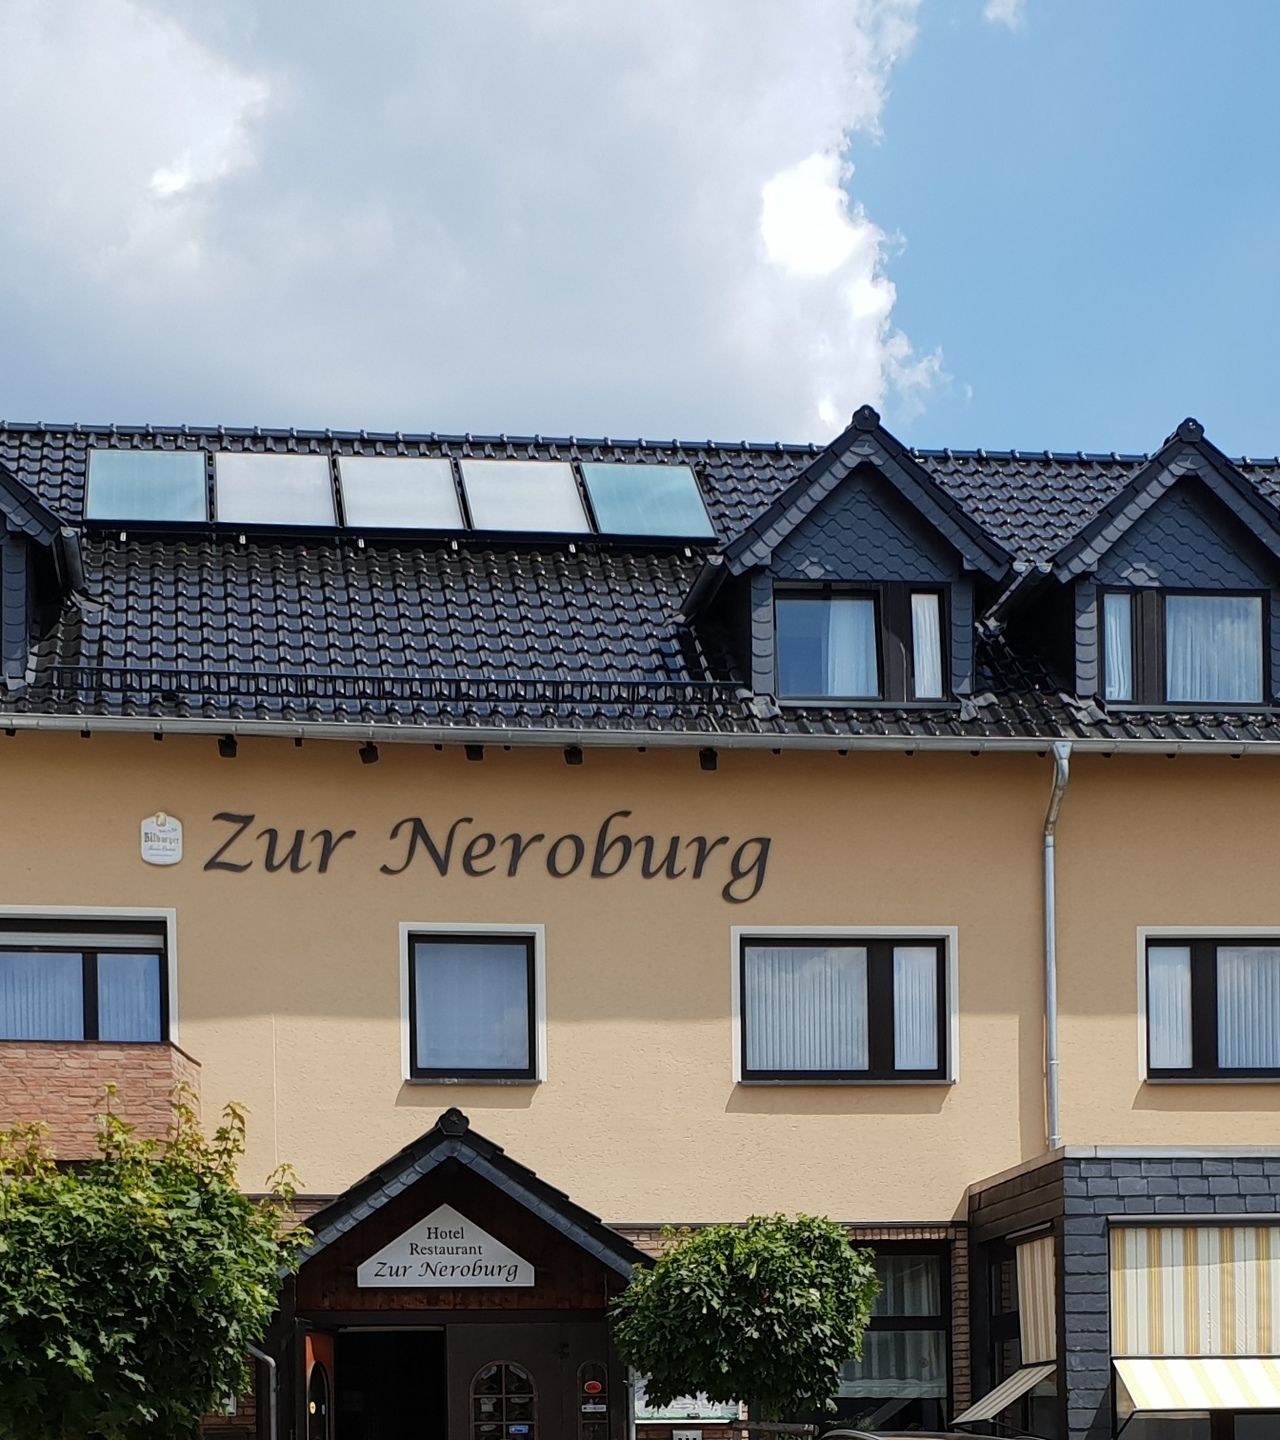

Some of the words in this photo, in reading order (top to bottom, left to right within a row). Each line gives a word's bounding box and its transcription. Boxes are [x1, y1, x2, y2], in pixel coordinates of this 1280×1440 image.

[203, 811, 356, 874] Zur
[379, 810, 772, 904] Neroburg
[426, 1227, 464, 1240] Hotel
[409, 1242, 483, 1256] Restaurant
[374, 1262, 412, 1278] Zur
[418, 1259, 519, 1283] Neroburg
